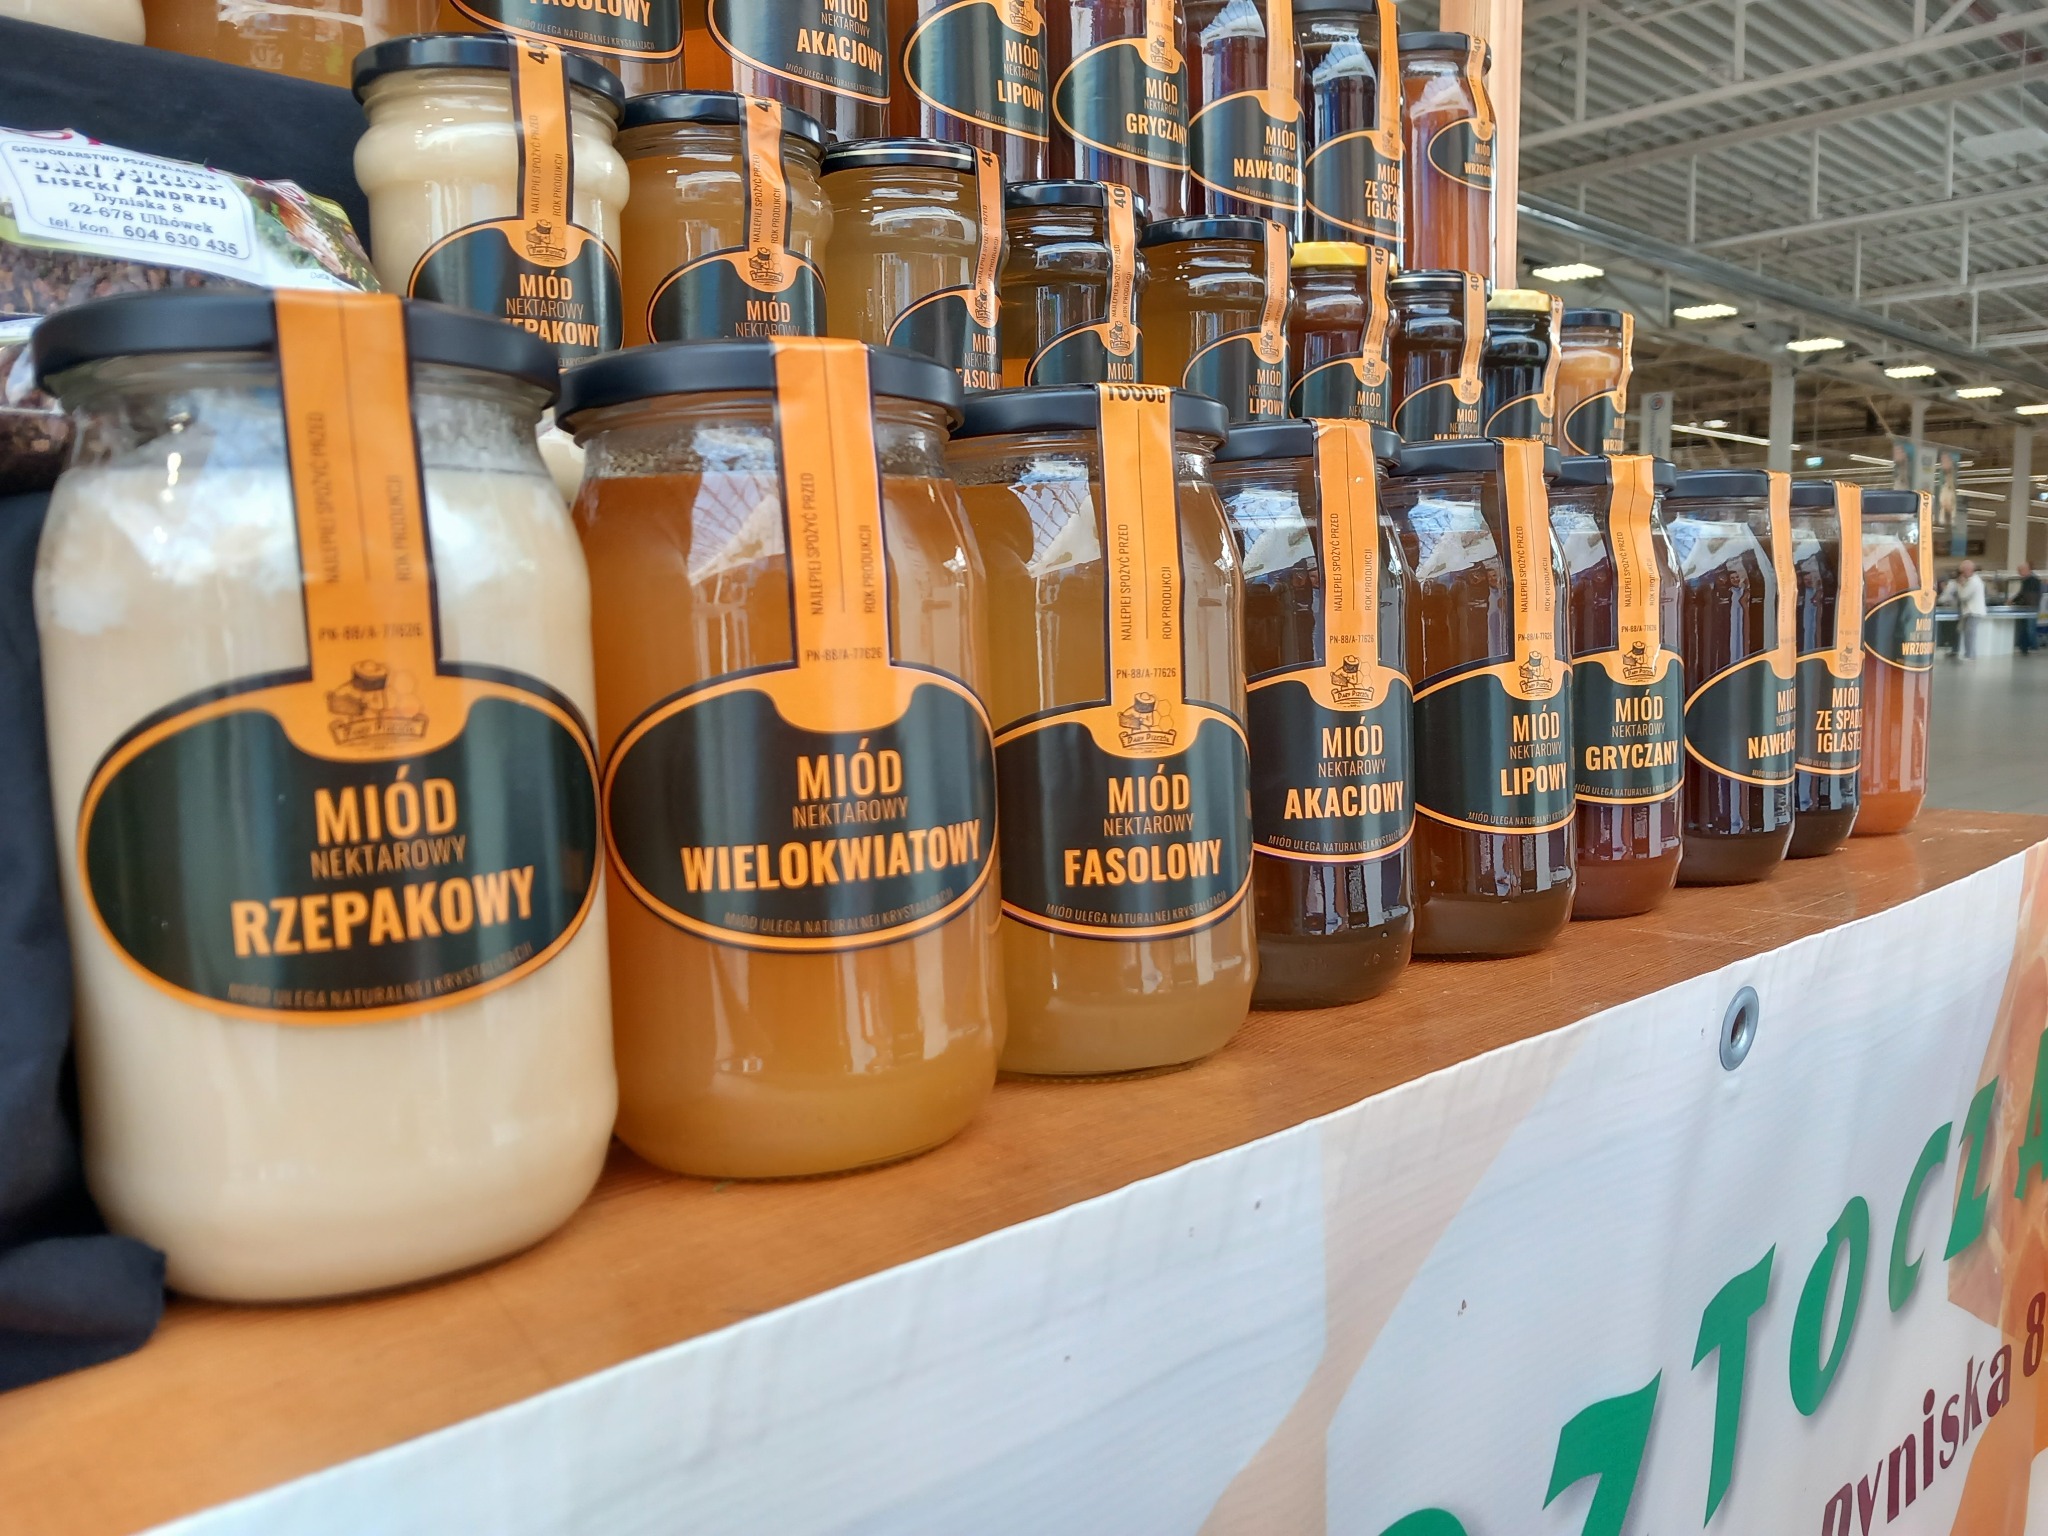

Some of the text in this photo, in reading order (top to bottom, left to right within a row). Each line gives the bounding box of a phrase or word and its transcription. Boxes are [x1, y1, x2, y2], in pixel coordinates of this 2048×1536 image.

[821, 12, 871, 38] NEKTAROWY
[797, 28, 883, 76] AKACJOWY
[1005, 39, 1039, 70] MIÓD
[997, 79, 1044, 113] LIPOWY
[1145, 75, 1178, 105] MIÓD
[1125, 112, 1188, 147] GRYCZANY
[1265, 124, 1296, 151] MIÓD
[11, 145, 119, 163] GOSPODARSTWO
[35, 174, 227, 210] LISECKI ANDRZEJ
[552, 153, 563, 217] ROK PRODUKCJI
[1364, 180, 1378, 199] ZE
[68, 201, 214, 234] 22-678 Ulhówek
[93, 192, 184, 214] Dyniska 8
[48, 216, 73, 230] tel.
[122, 225, 159, 241] 604
[165, 231, 200, 248] 630
[206, 238, 239, 255] 435
[519, 269, 573, 301] MIÓD
[506, 297, 584, 320] NEKTAROWY
[746, 295, 791, 323] MIÓD
[972, 329, 997, 355] MIÓD
[1107, 357, 1134, 380] MIÓD
[1256, 365, 1282, 386] MIÓD
[1249, 397, 1285, 417] LIPOWY
[1357, 387, 1382, 408] MIÓD
[1456, 405, 1478, 423] MIÓD
[801, 472, 824, 616] NAJLEPIEJ SPOŻYĆ PRZED
[858, 524, 876, 614] ROK PRODUKCJI
[1329, 513, 1343, 612] NAJLEPIEJ SPOŻYĆ PRZED
[1515, 526, 1528, 613] NAJLEPIEJ SPOŻYĆ PRZED
[1116, 523, 1132, 640] NAJLEPIEJ SPOŻYĆ PRZED
[1364, 548, 1373, 611] ROK PRODUKCJI
[1623, 577, 1632, 608] NAJLEPIEJ
[1161, 566, 1172, 640] ROK PRODUKCJI
[1329, 634, 1375, 645] PN-88/A-77626
[1116, 667, 1177, 680] PN-88/A-77626
[1615, 688, 1664, 723] MIÓD
[1832, 681, 1860, 708] MIÓD
[1512, 704, 1560, 743] MIÓD
[1612, 722, 1666, 738] NEKTAROWY
[1816, 710, 1833, 730] ZE
[1322, 715, 1384, 759] MIÓD
[1509, 741, 1562, 760] NEKTAROWY
[796, 737, 904, 801] MIÓD
[1318, 758, 1386, 778] NEKTAROWY
[1585, 739, 1679, 771] GRYCZANY
[1108, 763, 1190, 814] MIÓD
[1500, 762, 1567, 797] LIPOWY
[1592, 785, 1614, 796] ULEGA
[1615, 786, 1652, 797] NATURALNEJ
[313, 763, 459, 847] MIÓD
[791, 796, 909, 829] NEKTAROWY
[1283, 780, 1404, 820] AKACJOWY
[1103, 812, 1195, 837] NEKTAROWY
[1468, 811, 1488, 823] MIÓD
[1490, 814, 1514, 826] ULEGA
[310, 834, 467, 881] NEKTAROWY
[680, 818, 982, 893] WIELOKWIATOWY
[1268, 834, 1370, 853] MIÓD ULEGA NATURALNEJ
[1064, 838, 1222, 887] FASOLOWY
[230, 864, 535, 958] RZEPAKOWY
[1045, 889, 1227, 924] MIÓD ULEGA NATURALNEJ KRYSTALIZACJI
[760, 916, 801, 934] ULEGA
[803, 913, 881, 934] NATURALNEJ
[2023, 1291, 2047, 1378] 8
